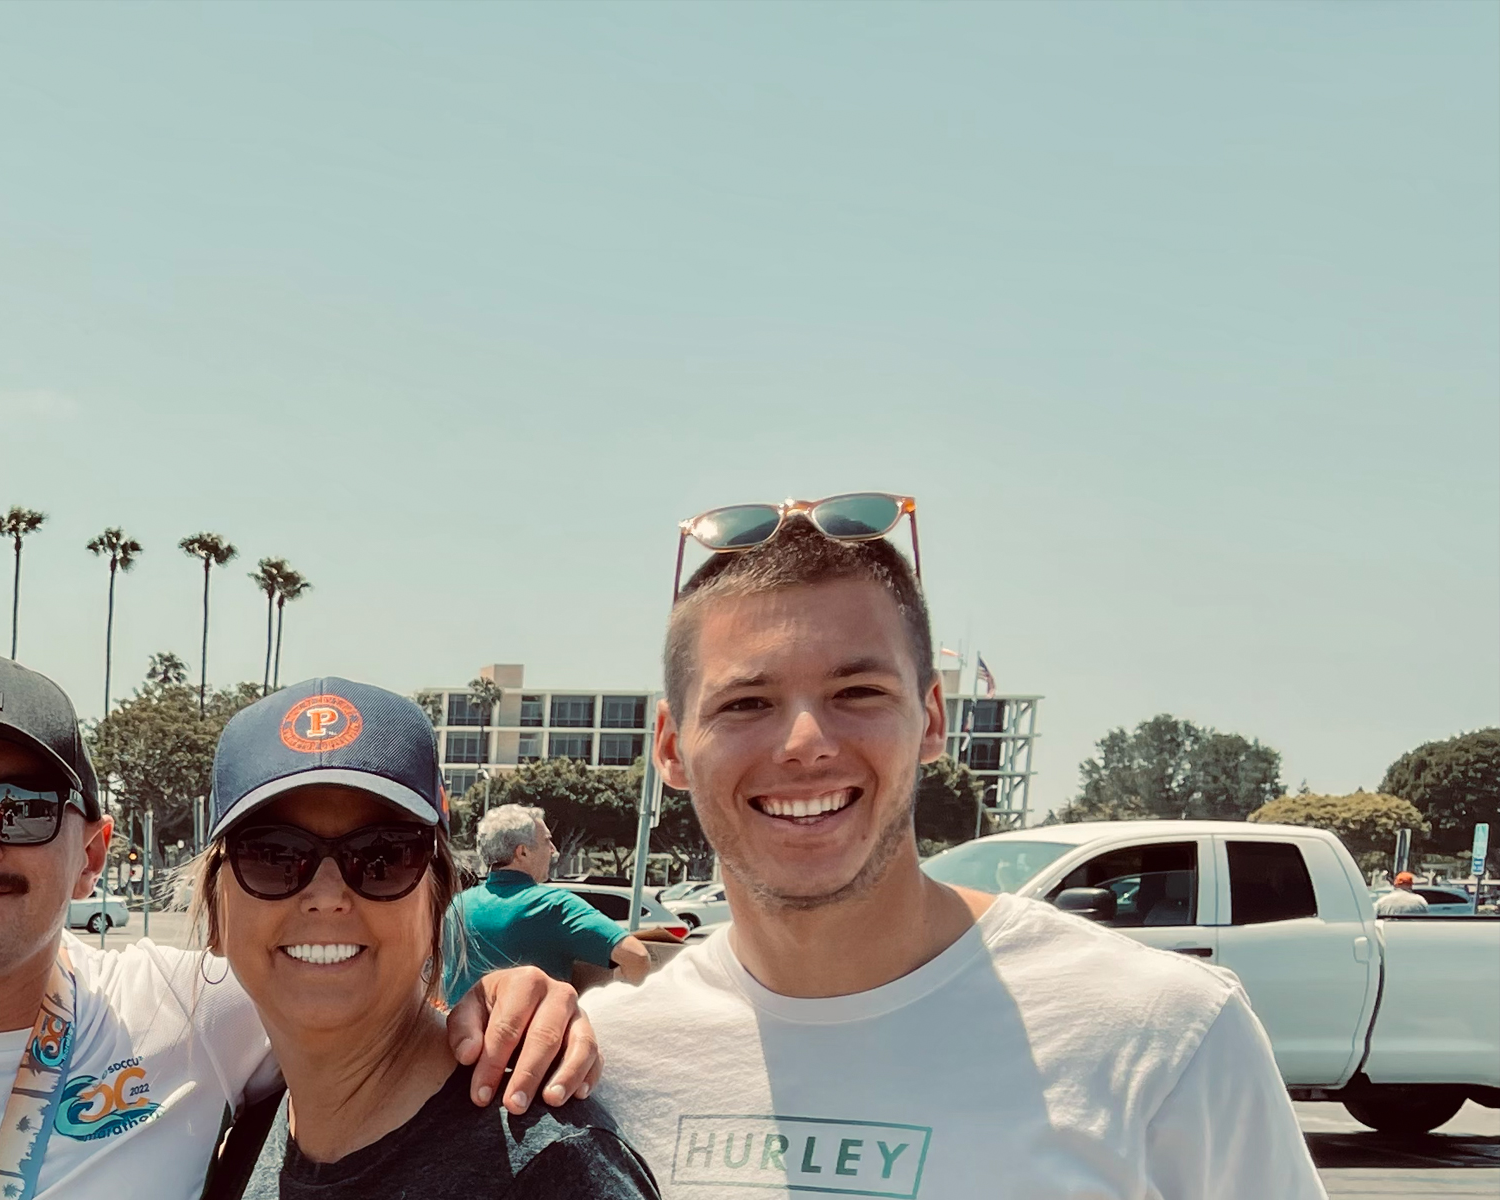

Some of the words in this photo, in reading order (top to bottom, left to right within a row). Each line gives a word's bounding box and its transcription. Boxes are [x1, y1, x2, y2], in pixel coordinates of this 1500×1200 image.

[306, 707, 338, 737] P
[107, 1057, 140, 1074] SDCCU
[129, 1083, 150, 1097] 2022
[686, 1132, 910, 1180] HURLEY
